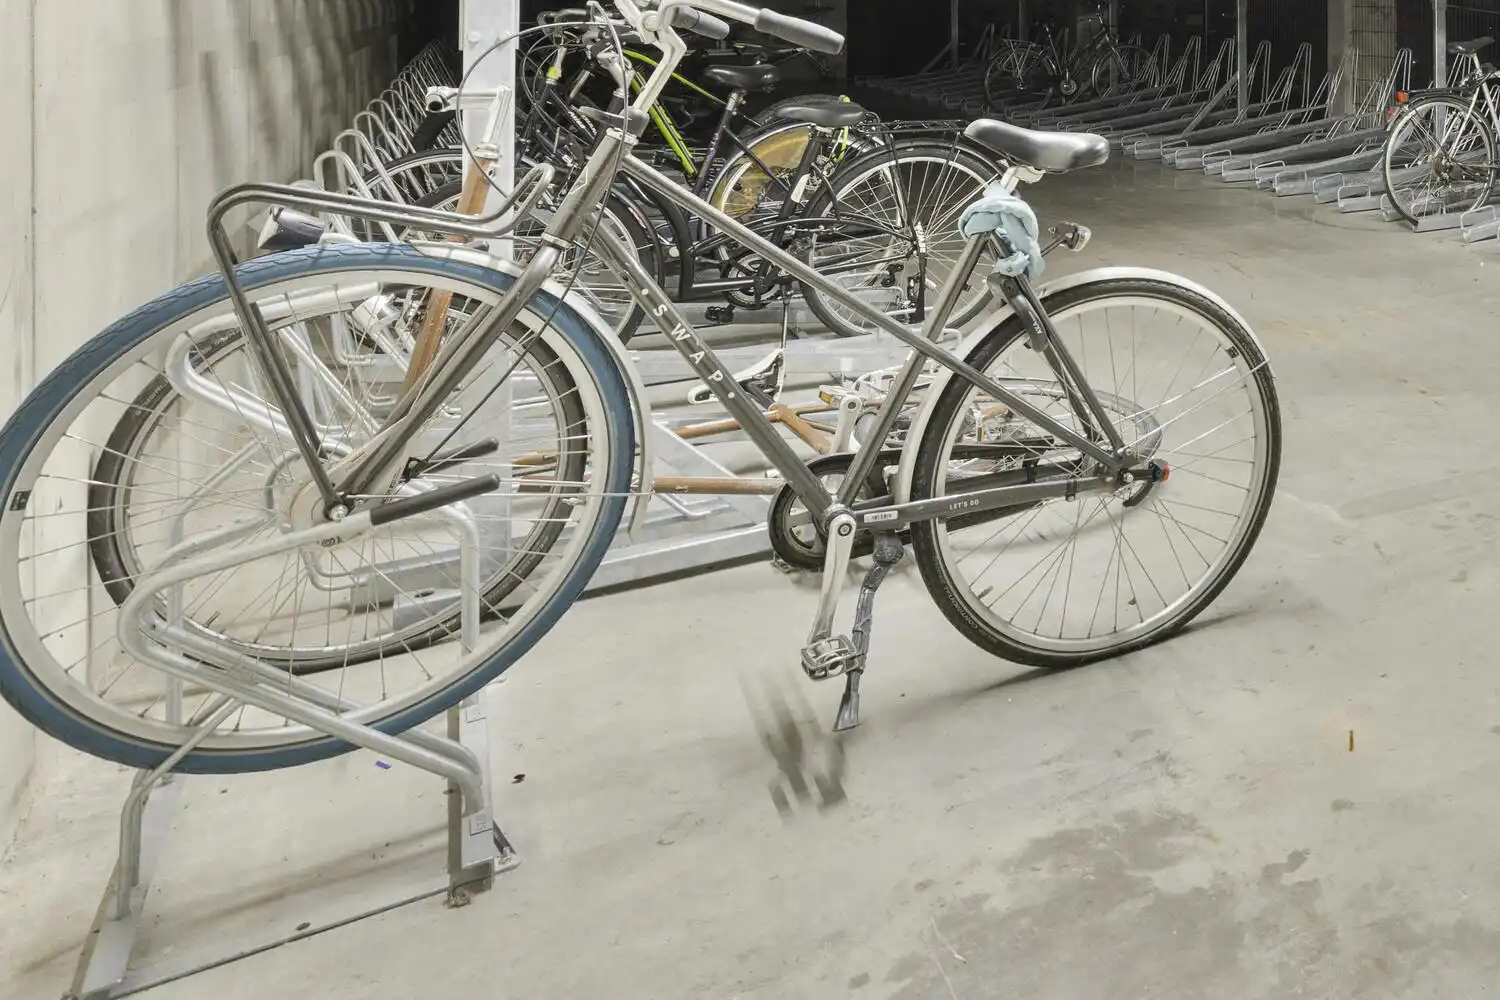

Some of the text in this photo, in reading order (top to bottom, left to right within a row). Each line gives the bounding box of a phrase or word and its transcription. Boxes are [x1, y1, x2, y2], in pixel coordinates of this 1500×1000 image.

[652, 303, 724, 382] SWAP
[949, 499, 980, 511] LET'S GO
